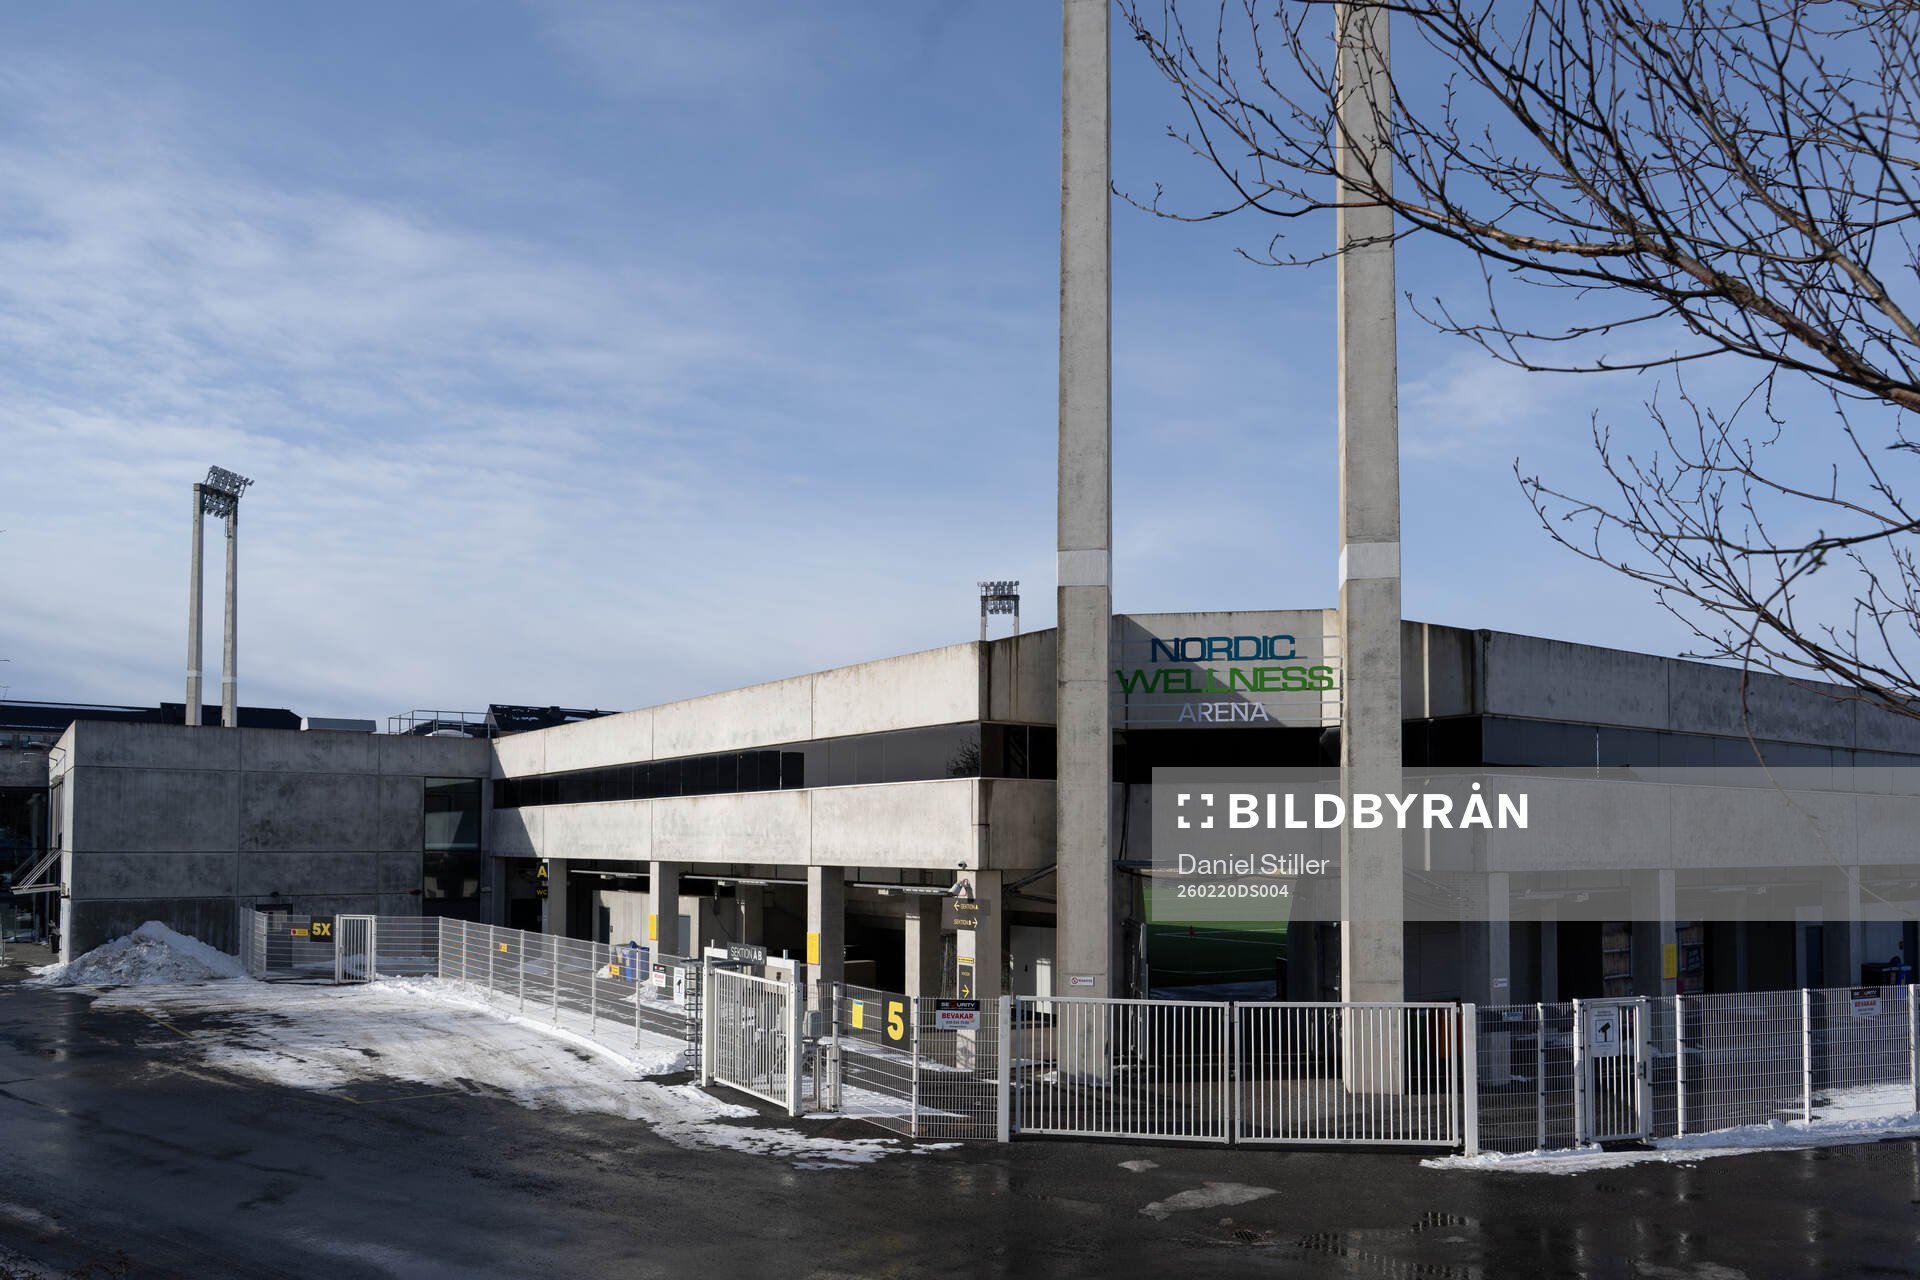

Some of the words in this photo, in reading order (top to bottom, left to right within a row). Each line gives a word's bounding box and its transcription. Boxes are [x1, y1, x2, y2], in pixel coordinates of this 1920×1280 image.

[1151, 635, 1296, 663] NORDIC
[1115, 665, 1334, 694] WELLNESS
[1178, 702, 1269, 722] ARENA
[537, 865, 548, 878] A
[312, 922, 331, 936] 5X
[730, 946, 752, 960] SEKTION
[887, 1001, 904, 1040] 5
[941, 1012, 974, 1020] BEVAKAR
